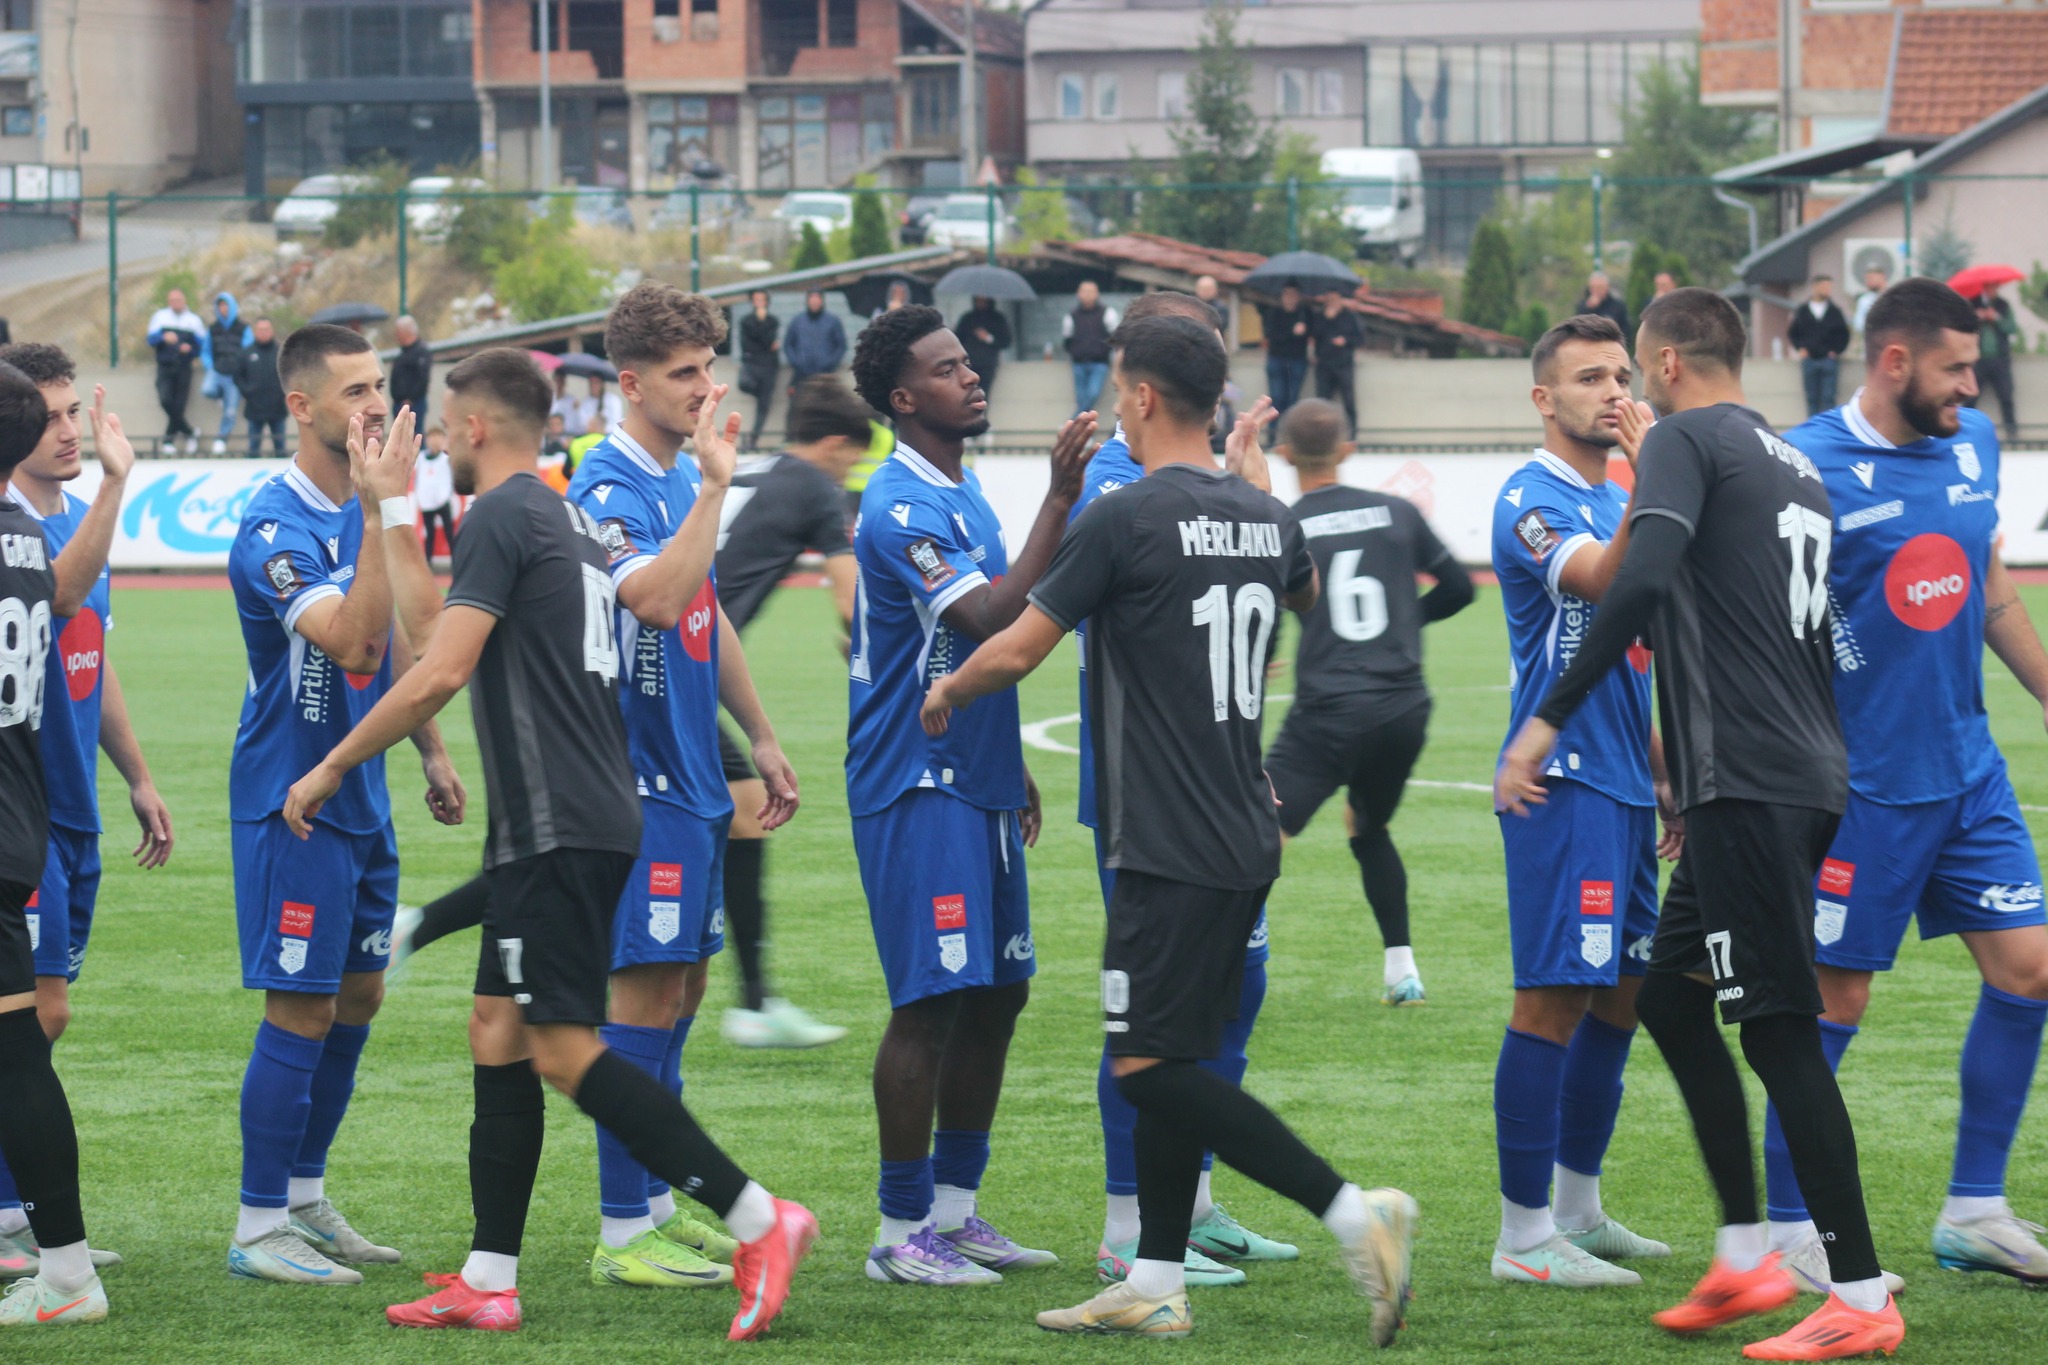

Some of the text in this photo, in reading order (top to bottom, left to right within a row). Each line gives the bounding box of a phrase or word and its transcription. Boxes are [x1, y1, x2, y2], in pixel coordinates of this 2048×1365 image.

[1327, 548, 1389, 641] 6
[1777, 502, 1832, 640] 17
[1192, 582, 1276, 722] 10
[1705, 930, 1734, 980] 17
